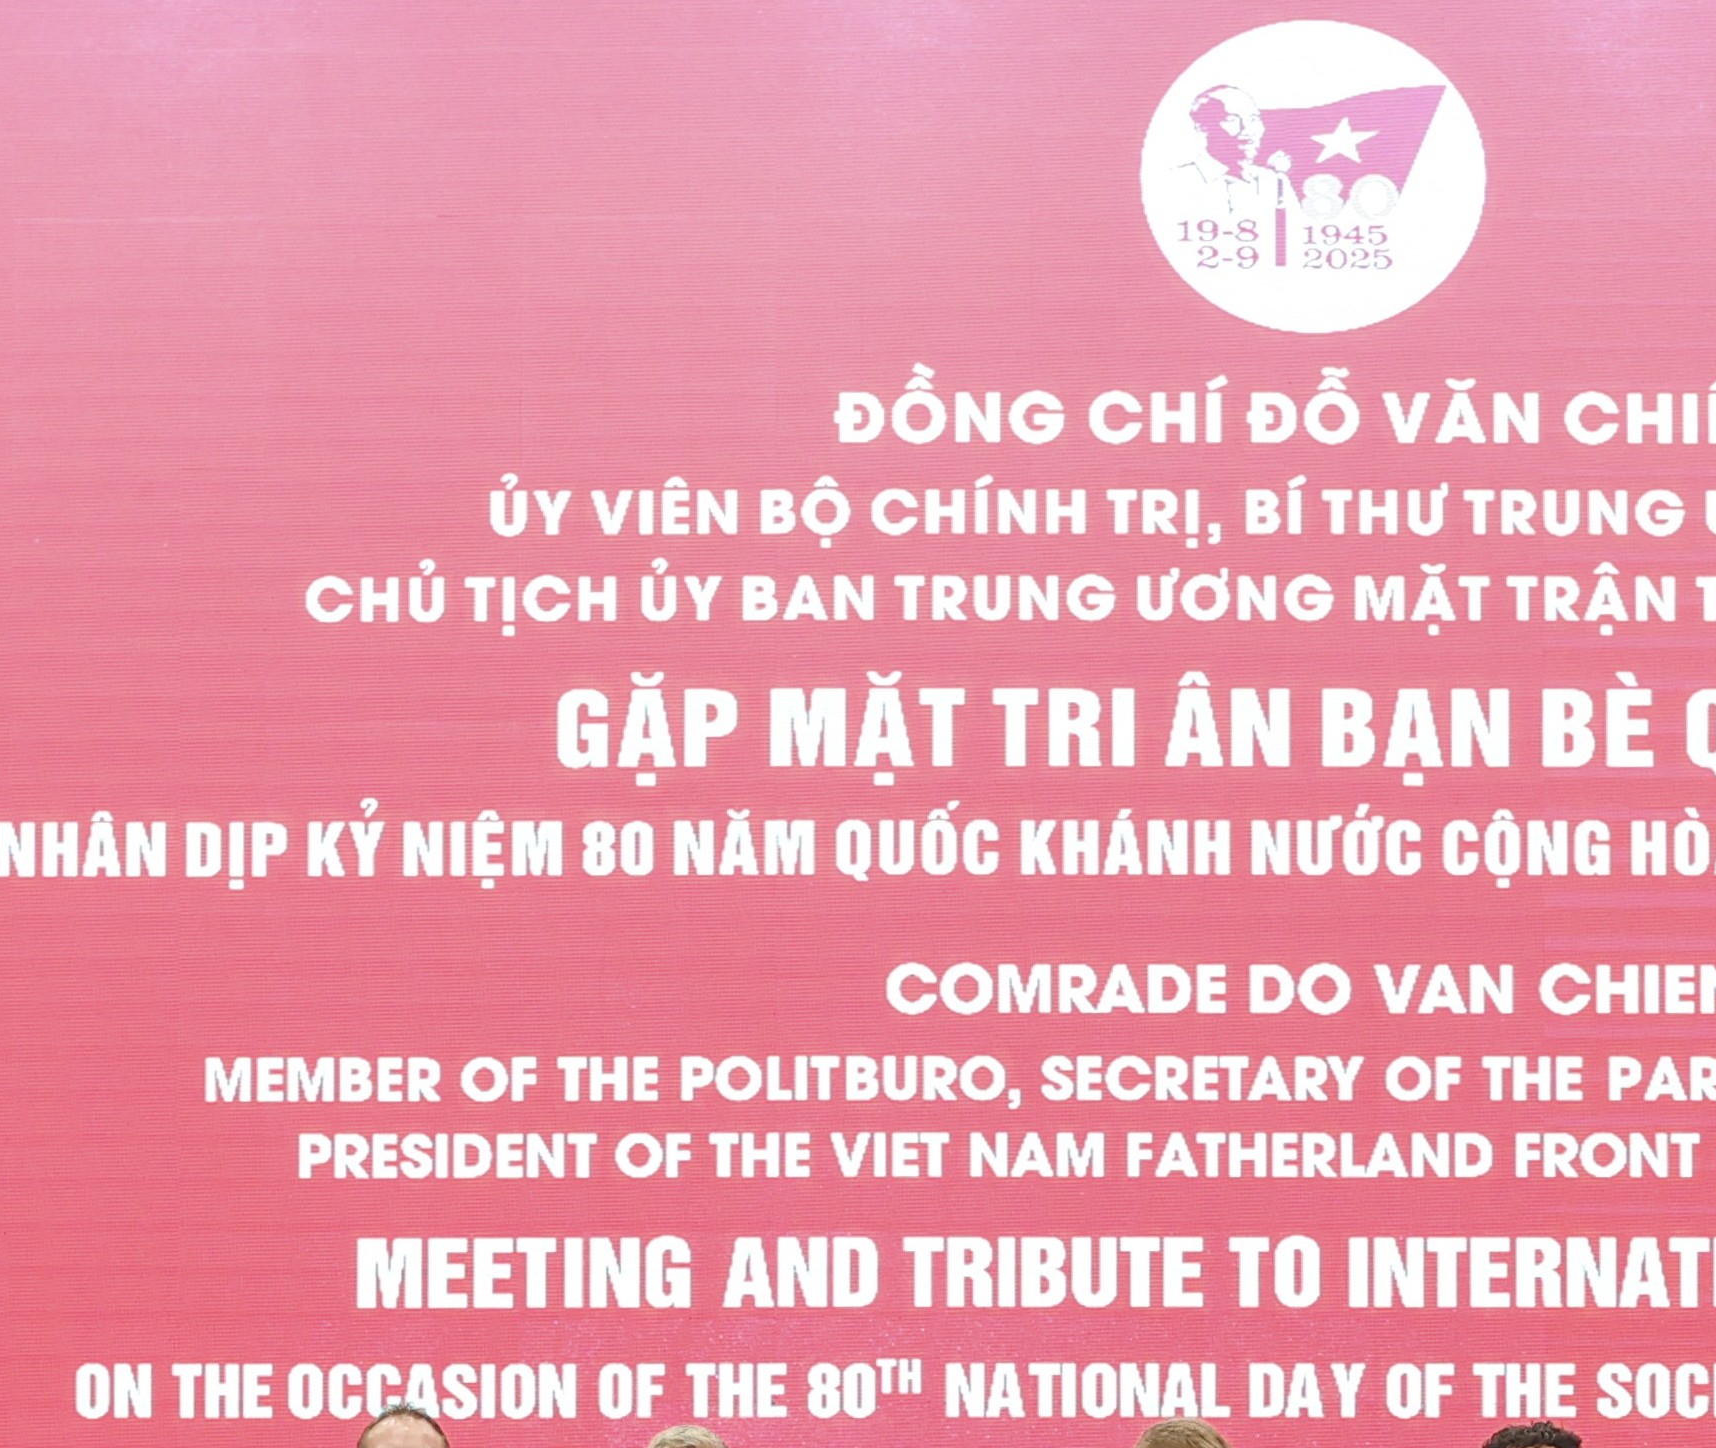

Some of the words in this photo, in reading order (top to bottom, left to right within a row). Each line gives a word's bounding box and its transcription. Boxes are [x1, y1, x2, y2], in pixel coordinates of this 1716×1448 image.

[1176, 218, 1260, 242] 19-8
[1196, 245, 1260, 269] 2-9
[1302, 224, 1388, 246] 1945
[1302, 248, 1393, 270] 2025
[833, 362, 1066, 445] ĐỒNG
[1088, 374, 1229, 445] CHÍ
[1246, 366, 1361, 445] ĐỖ
[1381, 377, 1540, 444] VĂN
[489, 472, 572, 538] ỦY
[590, 475, 739, 536] VIÊN
[760, 475, 852, 549] BỘ
[870, 474, 1087, 536] CHÍNH
[1106, 488, 1222, 549] TRỊ,
[1245, 474, 1307, 535] BÍ
[1321, 482, 1449, 537] THƯ
[1463, 489, 1686, 537] TRUNG
[305, 558, 445, 623] CHỦ
[464, 574, 618, 637] TỊCH
[640, 557, 723, 622] ỦY
[741, 574, 875, 621] BAN
[893, 573, 1117, 622] TRUNG
[1136, 567, 1335, 622] ƯƠNG
[1354, 563, 1491, 636] MẶT
[1506, 561, 1676, 636] TRẬN
[556, 671, 738, 787] GẶP
[769, 670, 966, 786] MẶT
[992, 687, 1136, 767] TRI
[1165, 670, 1291, 767] ÂN
[1321, 688, 1510, 787] BẠN
[1542, 671, 1654, 768] BÈ
[185, 821, 288, 890] DỊP
[307, 797, 385, 877] KỶ
[402, 809, 563, 889] NIỆM
[582, 820, 654, 876] 80
[673, 808, 816, 876] NĂM
[835, 800, 999, 882] QUỐC
[1020, 808, 1231, 876] KHÁNH
[1251, 803, 1422, 876] NƯỚC
[1442, 809, 1611, 889] CỘNG
[886, 962, 1227, 1015] COMRADE
[1249, 962, 1352, 1016] DO
[1373, 964, 1514, 1014] VAN
[205, 1056, 441, 1103] MEMBER
[460, 1056, 537, 1103] OF
[557, 1056, 659, 1102] THE
[680, 1055, 1021, 1110] POLITBURO,
[1041, 1055, 1364, 1101] SECRETARY
[1385, 1055, 1462, 1102] OF
[1481, 1055, 1583, 1101] THE
[298, 1132, 598, 1179] PRESIDENT
[614, 1132, 692, 1178] OF
[708, 1132, 811, 1178] THE
[830, 1132, 950, 1178] VIET
[969, 1132, 1105, 1178] NAM
[1127, 1132, 1493, 1178] FATHERLAND
[1515, 1132, 1701, 1178] FRONT
[356, 1235, 691, 1309] MEETING
[723, 1236, 879, 1308] AND
[903, 1236, 1204, 1308] TRIBUTE
[1228, 1235, 1321, 1308] TO
[75, 1363, 152, 1419] ON
[171, 1363, 273, 1419] THE
[288, 1362, 577, 1420] OCCASION
[598, 1363, 666, 1420] OF
[685, 1362, 788, 1418] THE
[807, 1358, 922, 1419] 80TH
[945, 1362, 1231, 1419] NATIONAL
[1248, 1362, 1366, 1418] DAY
[1386, 1363, 1455, 1419] OF
[1472, 1363, 1577, 1418] THE
